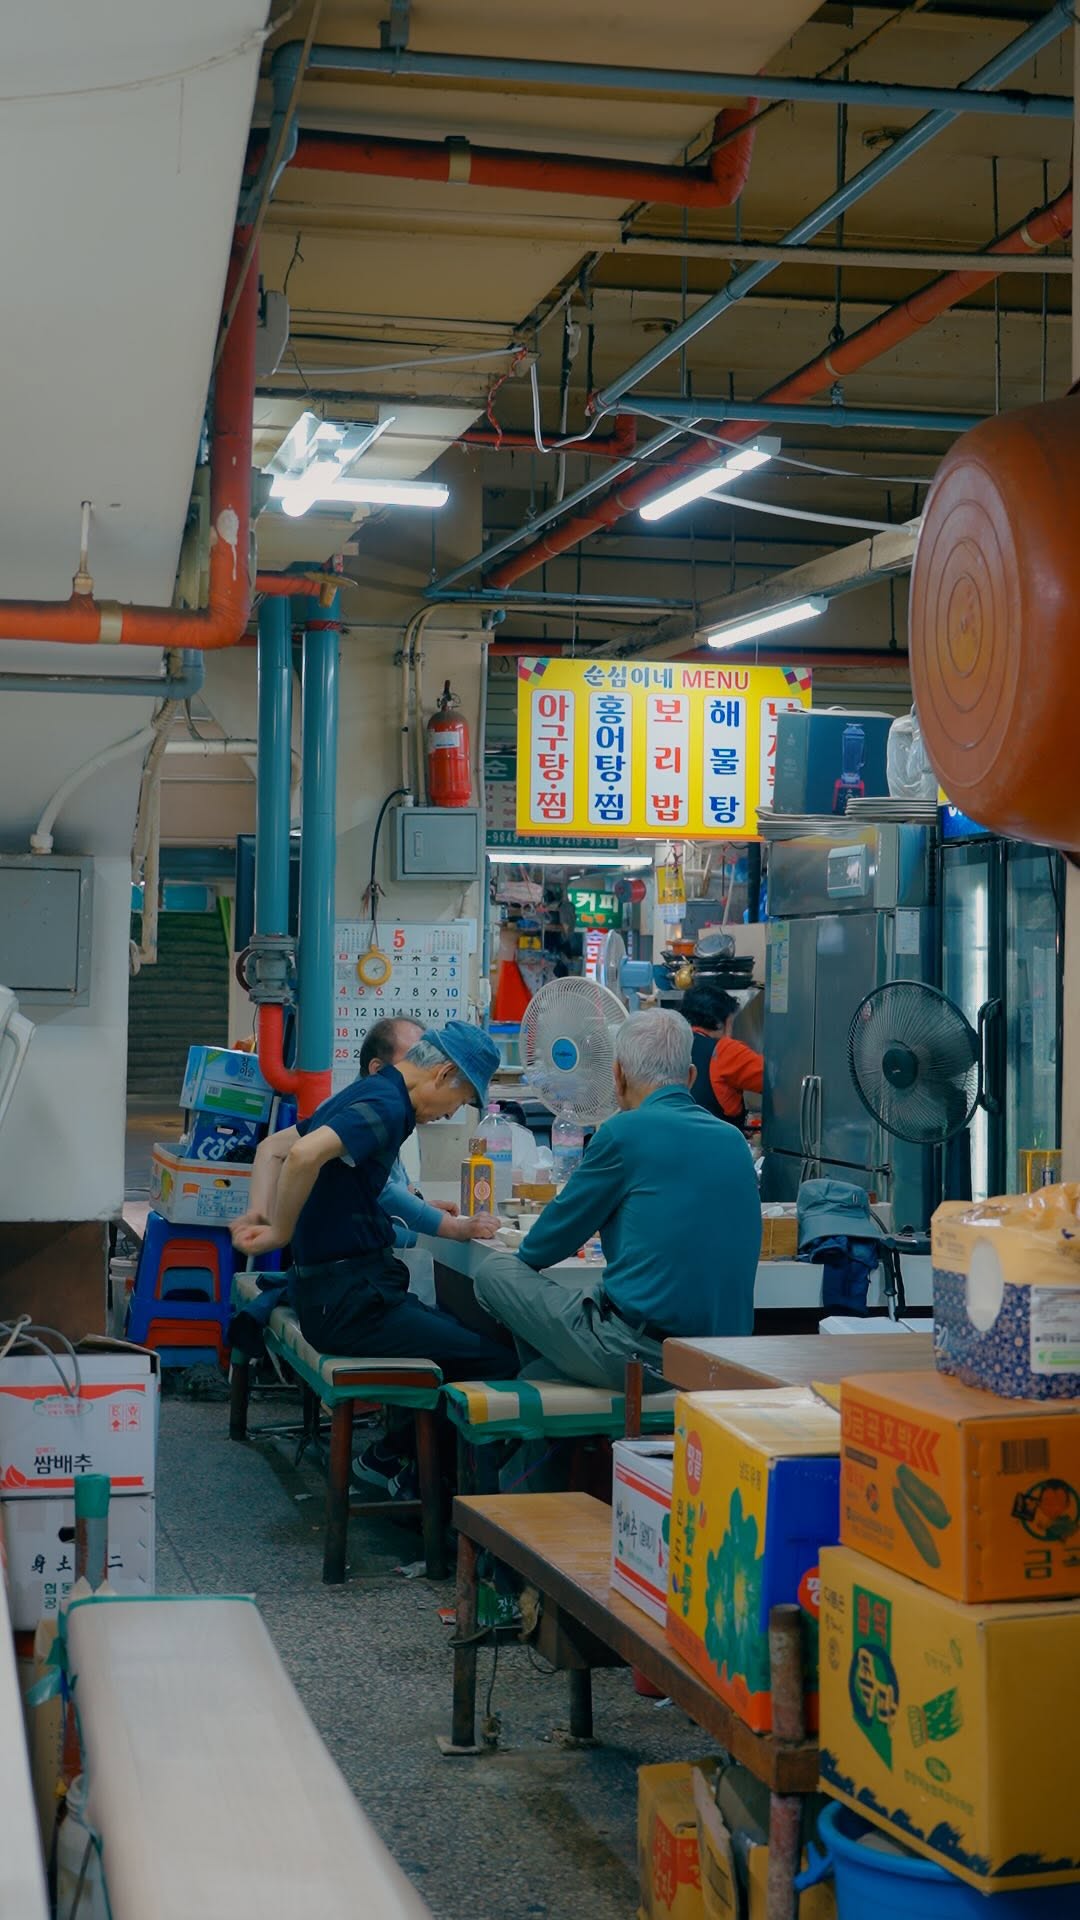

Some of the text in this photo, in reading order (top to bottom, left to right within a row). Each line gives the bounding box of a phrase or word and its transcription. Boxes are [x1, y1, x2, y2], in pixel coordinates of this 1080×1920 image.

[583, 664, 749, 690] 순심이네 MENU
[652, 699, 683, 822] 보리밥
[709, 700, 740, 824] 해물탕
[568, 892, 619, 913] 커피
[393, 929, 405, 948] 5
[431, 967, 438, 977] 2
[449, 967, 456, 977] 3
[339, 986, 458, 997] 4 5 6 7 8 9 10
[337, 1007, 457, 1018] 11 12 13 14 15 16 17
[336, 1028, 367, 1037] 18 19
[335, 1049, 348, 1058] 25
[34, 1454, 94, 1475] 쌈배추
